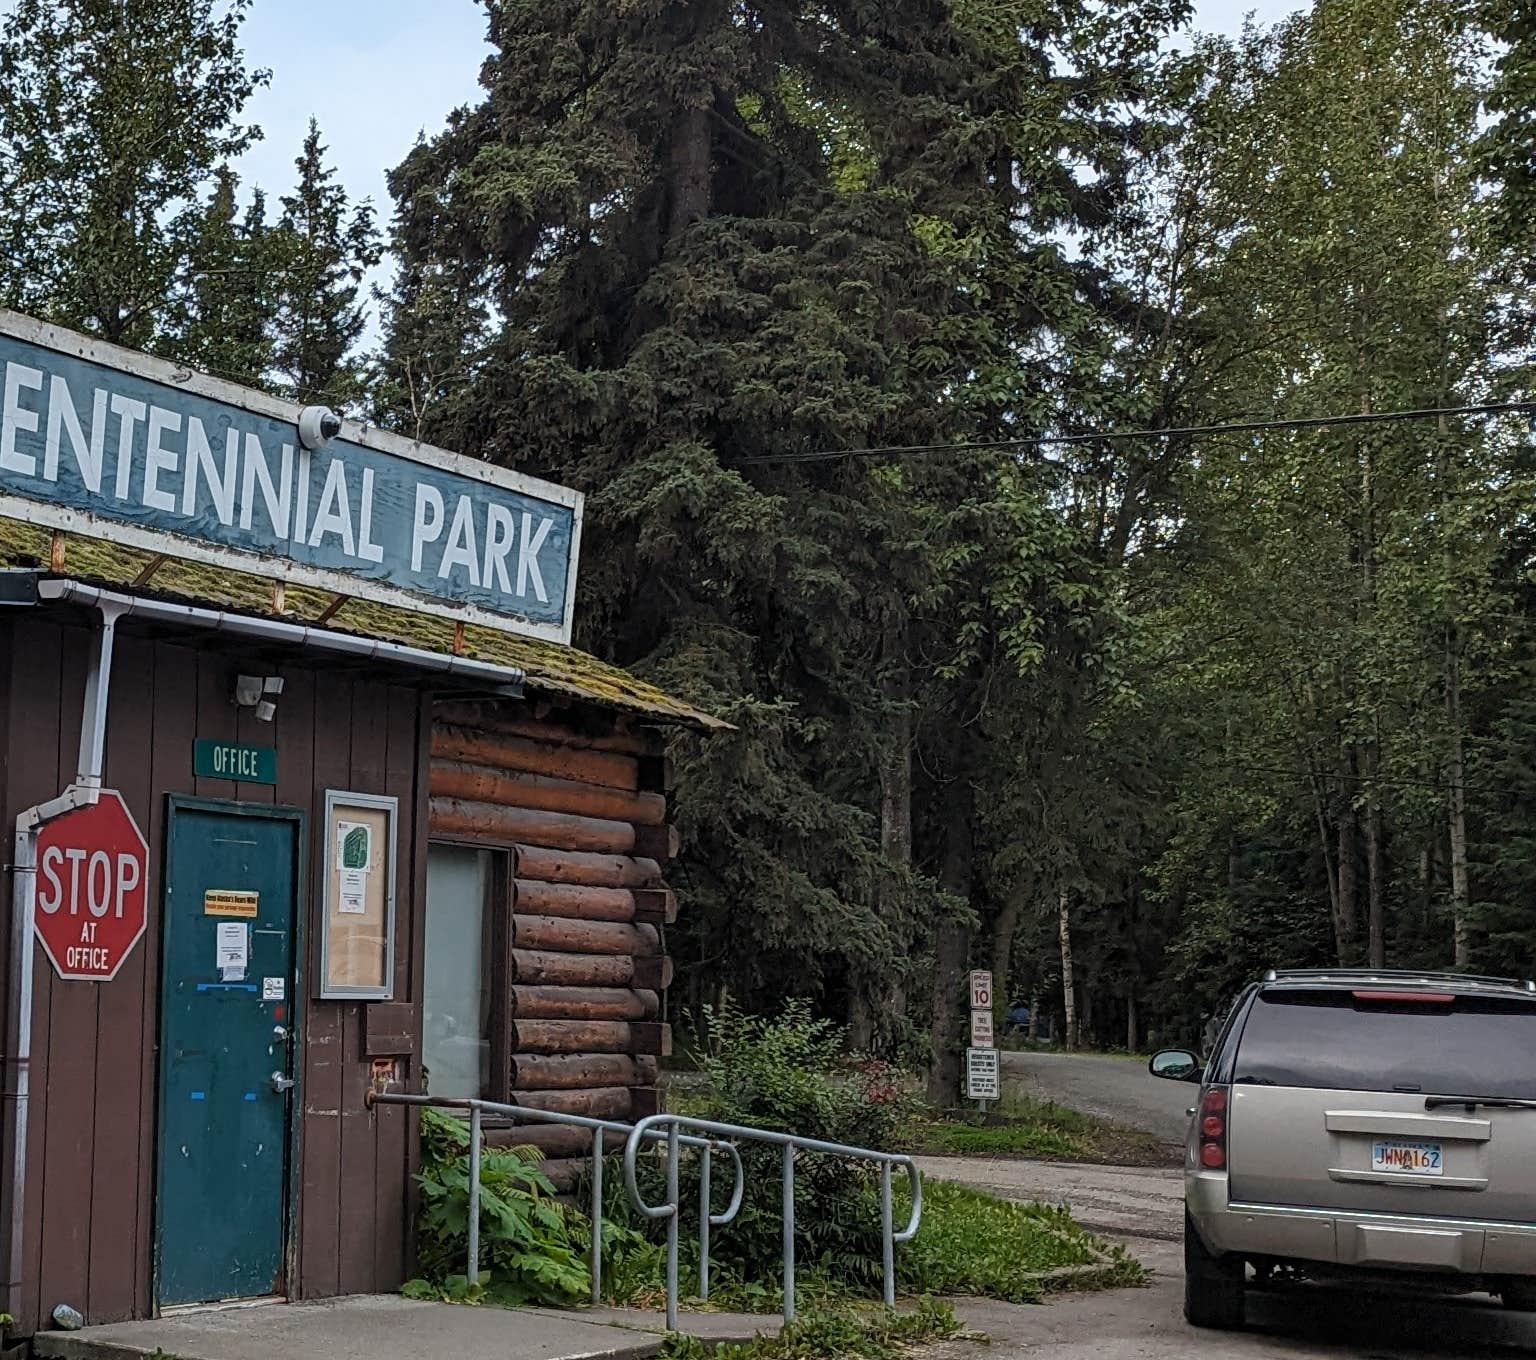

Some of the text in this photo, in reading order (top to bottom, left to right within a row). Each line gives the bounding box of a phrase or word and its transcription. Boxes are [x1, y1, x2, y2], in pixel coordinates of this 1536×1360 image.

[411, 482, 555, 604] PARK
[213, 745, 258, 777] OFFICE
[39, 846, 139, 918] STOP
[81, 921, 97, 943] AT
[66, 946, 109, 970] OFFICE
[974, 990, 989, 1004] 10
